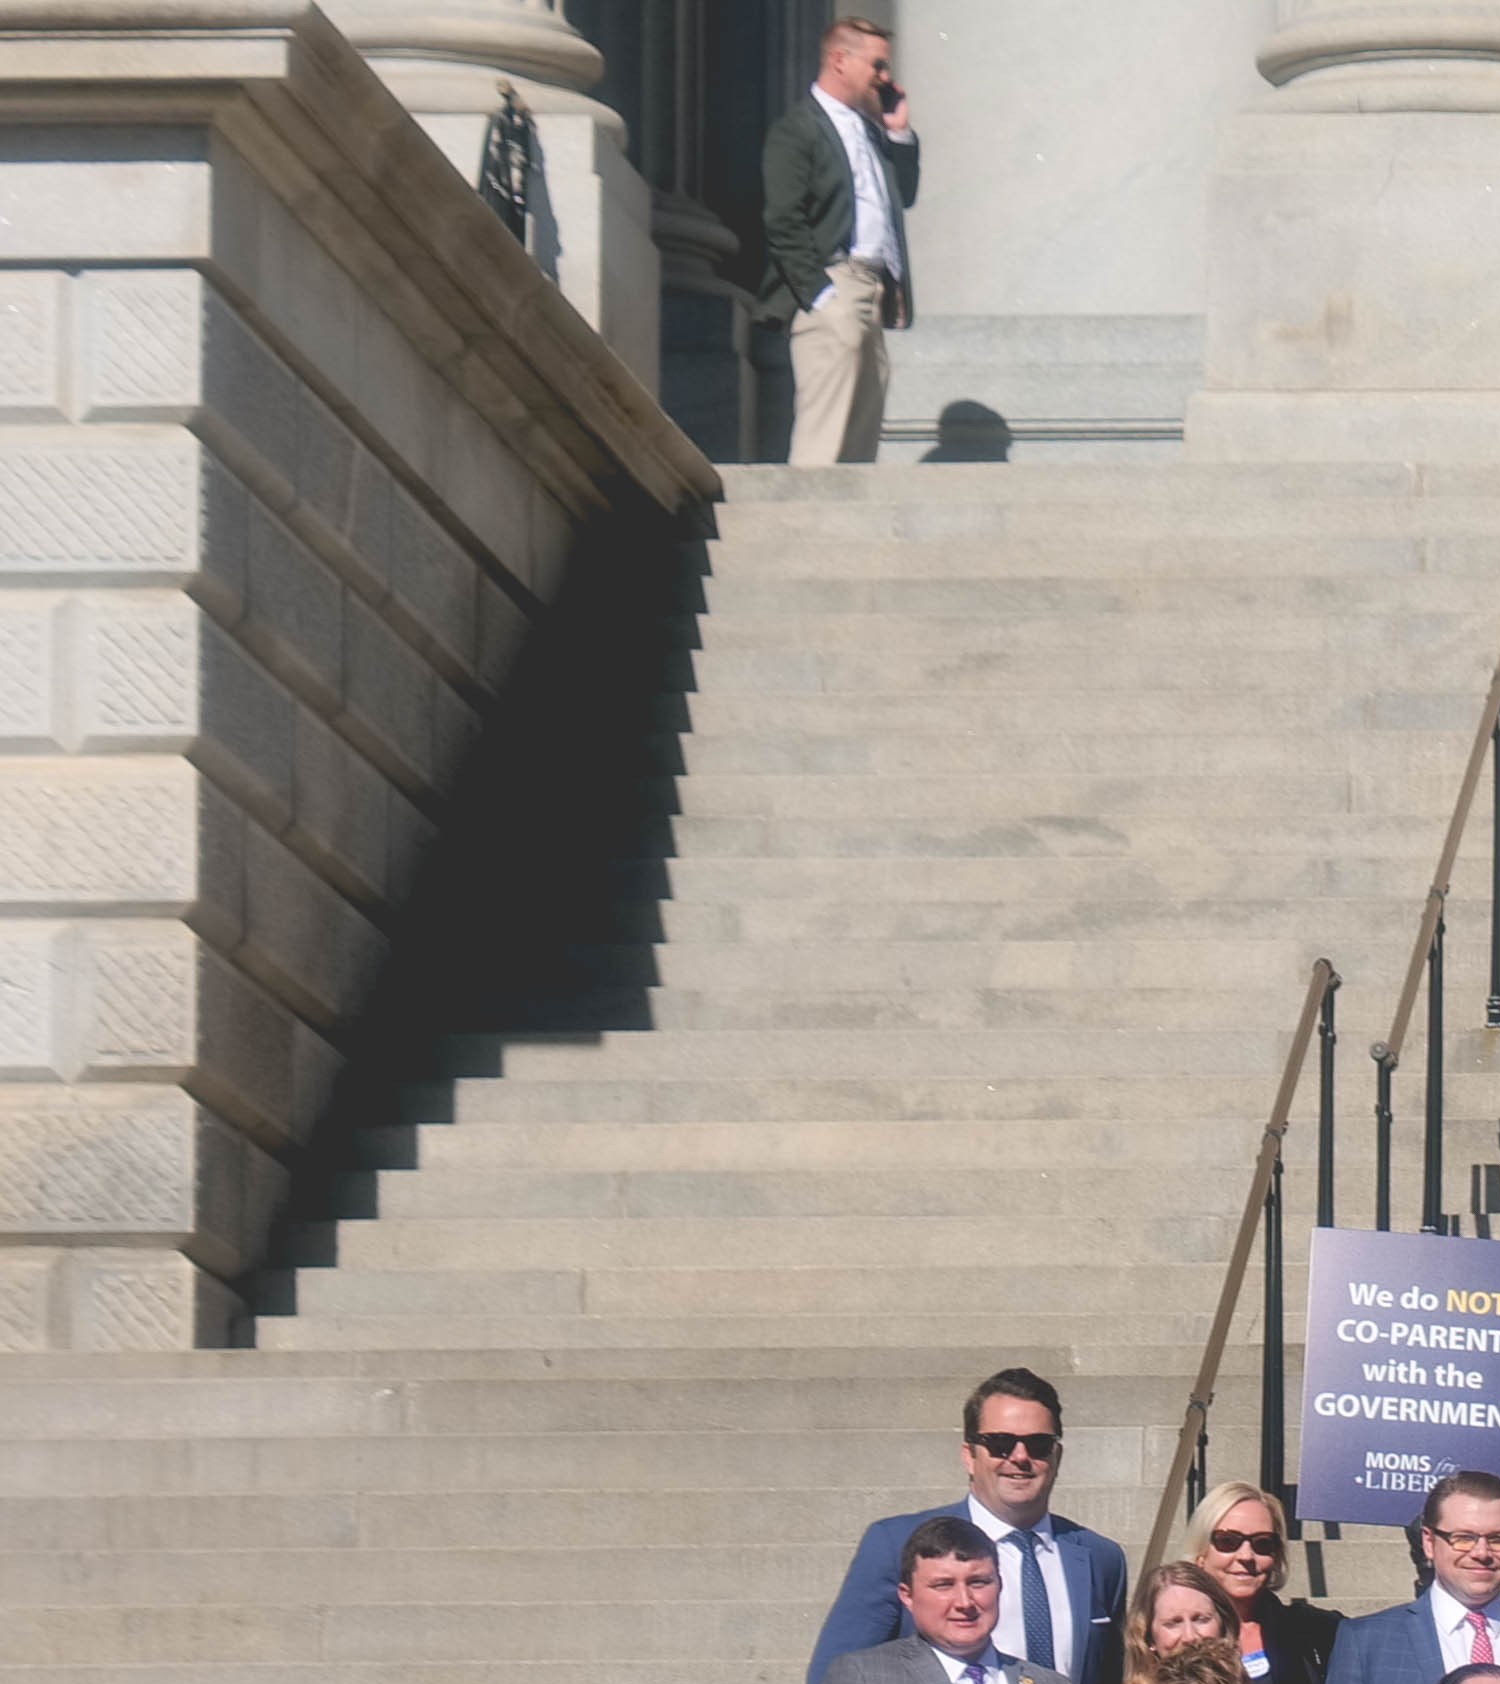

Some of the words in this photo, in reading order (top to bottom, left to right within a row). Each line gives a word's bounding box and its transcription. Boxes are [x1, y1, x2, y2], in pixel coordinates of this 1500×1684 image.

[1348, 1282, 1393, 1308] We
[1400, 1285, 1438, 1311] do
[1362, 1359, 1427, 1386] with
[1435, 1362, 1483, 1389] the
[1365, 1451, 1431, 1473] MOMS
[1366, 1473, 1450, 1492] LIBER
